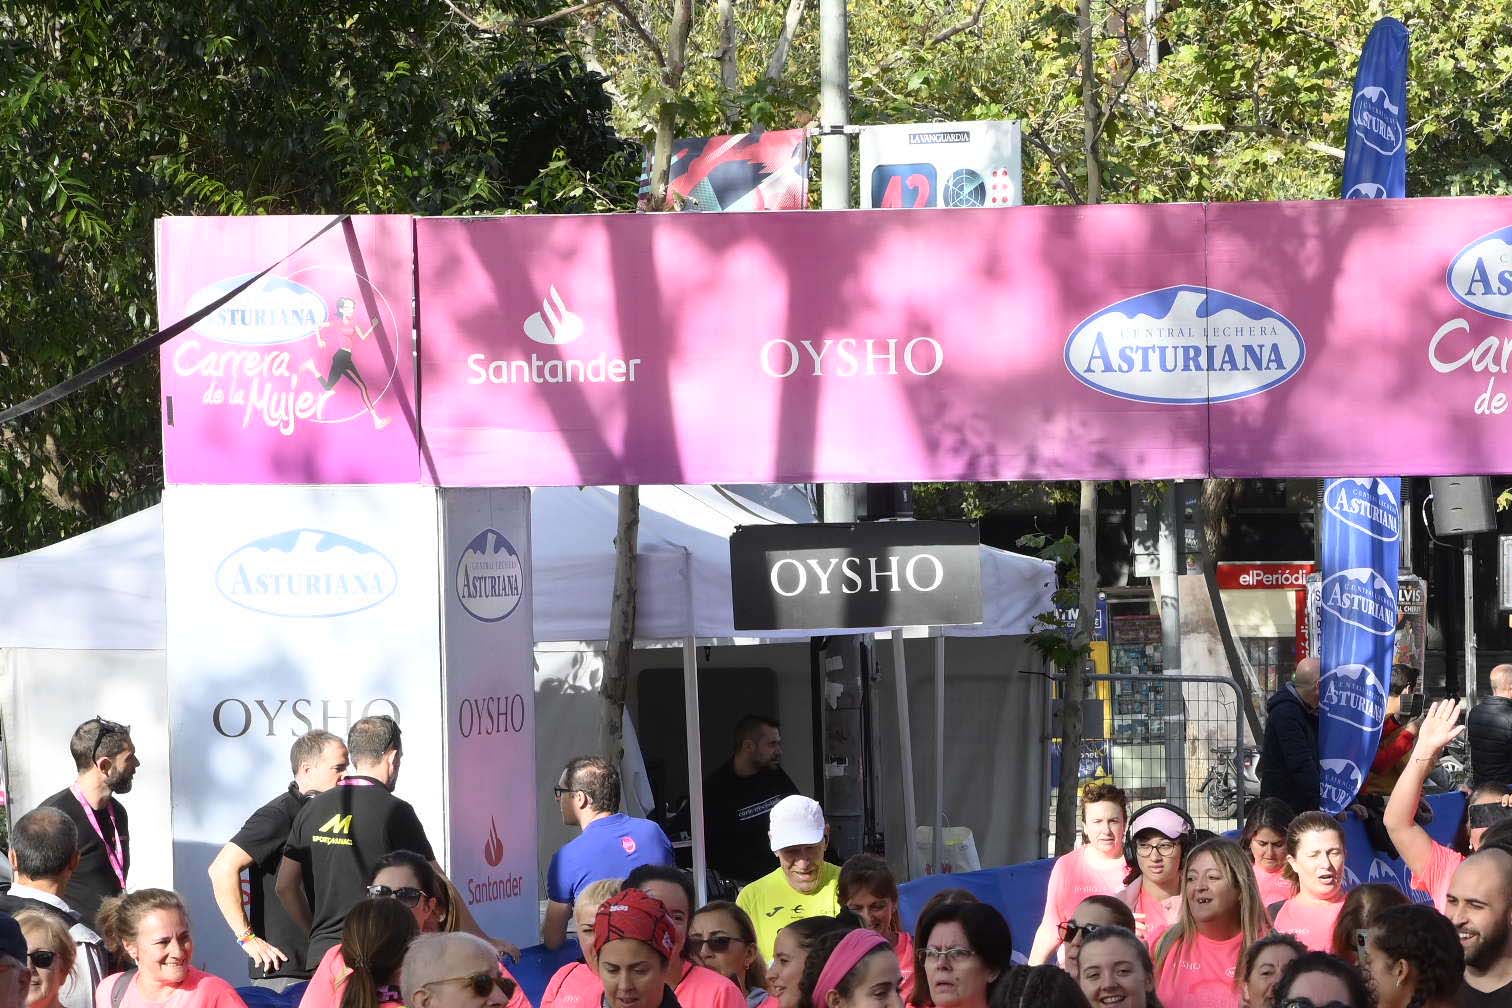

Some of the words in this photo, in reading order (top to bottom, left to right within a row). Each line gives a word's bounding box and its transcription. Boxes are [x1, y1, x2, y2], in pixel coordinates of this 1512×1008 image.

[1083, 326, 1287, 373] ASTURIANA
[1119, 326, 1194, 338] CENTRAL
[1202, 325, 1279, 337] LECHERA
[174, 340, 291, 377] Carrera
[468, 352, 641, 384] Santander
[760, 337, 944, 378] OYSHO
[203, 382, 223, 405] de
[230, 382, 245, 405] la
[242, 375, 335, 435] Mujer
[1474, 377, 1508, 414] de
[231, 564, 387, 596] ASTURIANA
[462, 563, 519, 599] ASTURIANA
[770, 553, 944, 597] OYSHO
[1327, 582, 1394, 627] ASTURIANA
[458, 694, 525, 738] OYSHO
[467, 873, 523, 906] Santander
